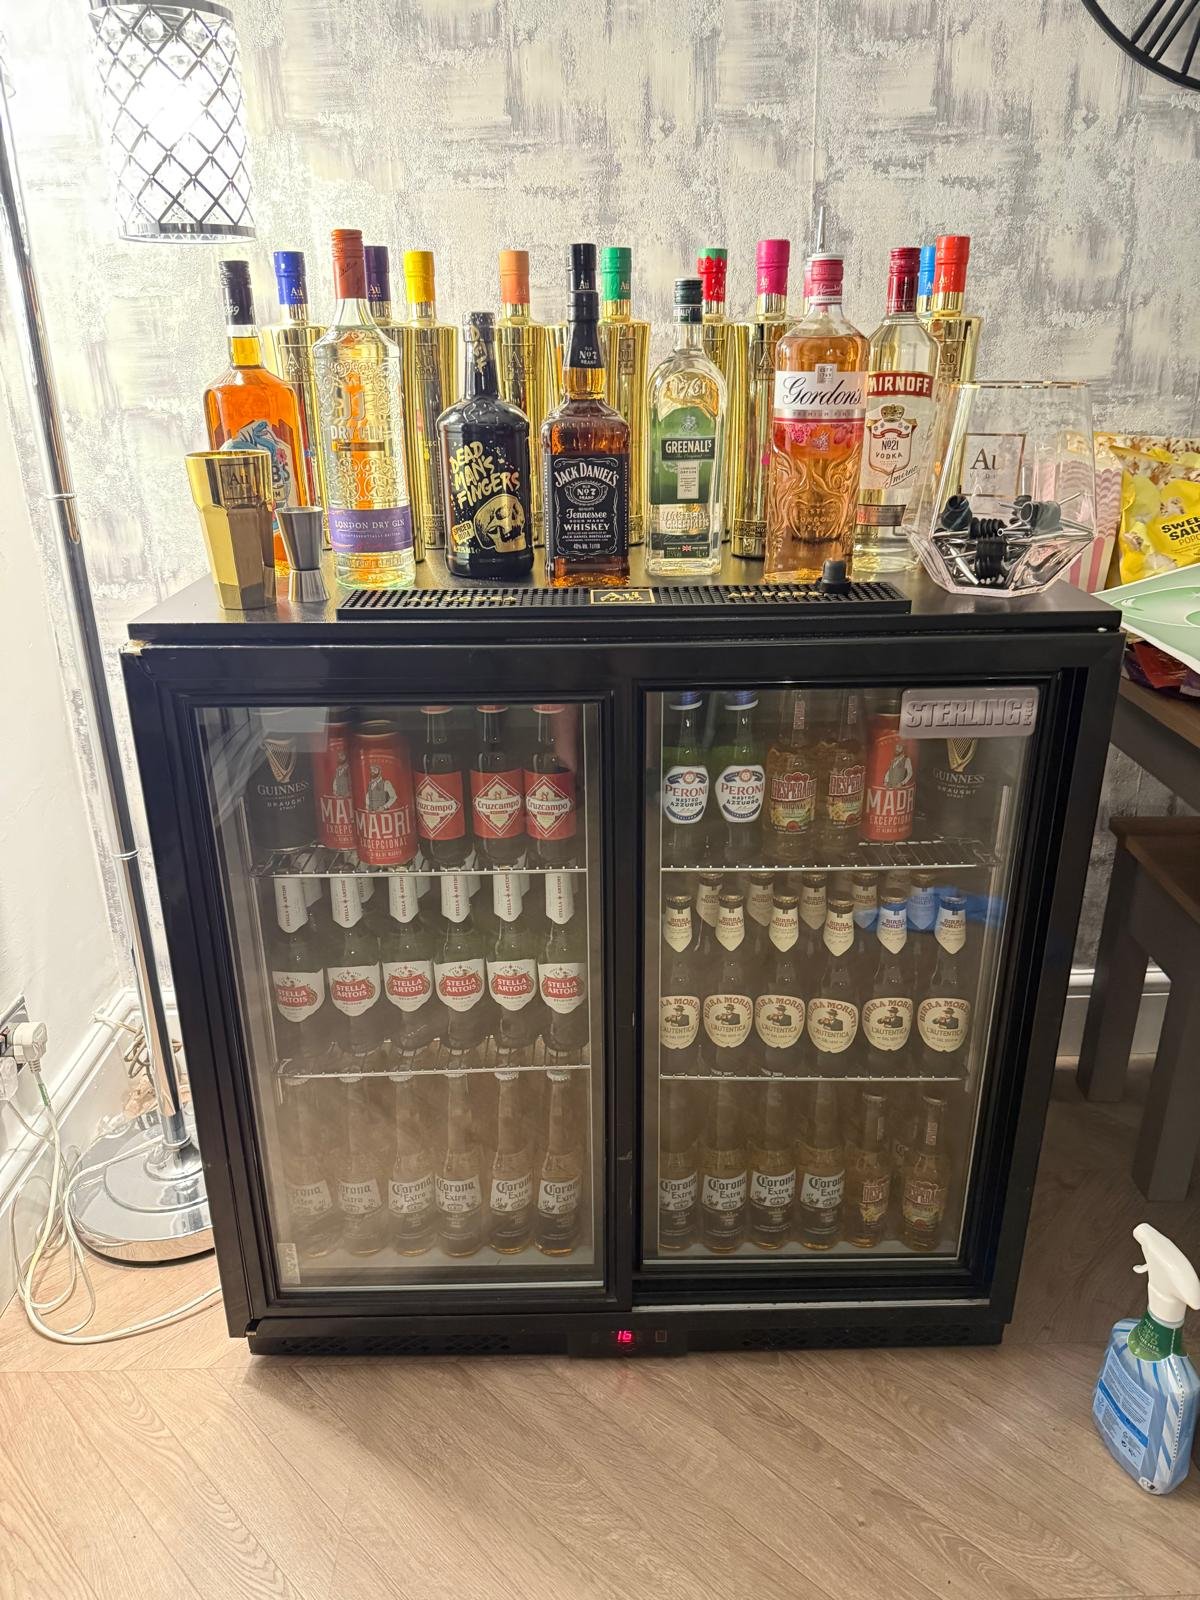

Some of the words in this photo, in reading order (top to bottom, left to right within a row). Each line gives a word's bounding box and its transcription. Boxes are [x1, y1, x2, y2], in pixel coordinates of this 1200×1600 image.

[868, 376, 930, 393] MIRNOFF
[783, 376, 862, 405] Gordon's
[449, 441, 483, 473] DEAD
[454, 455, 495, 490] MAN'S
[553, 466, 580, 488] JACK
[579, 462, 620, 488] DANIEL'S
[456, 471, 520, 509] FINGERS
[566, 508, 608, 519] Tennessee
[335, 519, 368, 529] LONDON
[372, 521, 390, 529] DRY
[392, 519, 405, 527] GIN
[563, 523, 610, 531] WHISKEY
[906, 699, 1023, 727] STERLING
[933, 767, 985, 784] GUINNESS
[477, 800, 521, 811] Cruzcampo
[527, 801, 568, 811] Cruzcampo
[866, 786, 914, 815] MADR
[416, 801, 453, 813] ruzcampo
[335, 983, 367, 993] STELLA
[392, 979, 423, 988] STELLA
[445, 978, 477, 988] STELLA
[446, 984, 477, 992] ARTOIS
[496, 978, 527, 987] STELLA
[497, 984, 528, 992] ARTOIS
[547, 980, 577, 989] STELLA
[336, 990, 368, 998] ARTOIS
[393, 985, 423, 993] ARTOIS
[547, 987, 578, 995] ARTOIS
[391, 1177, 432, 1197] Corona
[436, 1178, 475, 1193] Corona
[708, 1176, 746, 1193] Corona
[756, 1174, 795, 1190] Corona
[720, 1190, 741, 1199] Extra
[768, 1187, 790, 1196] Extra
